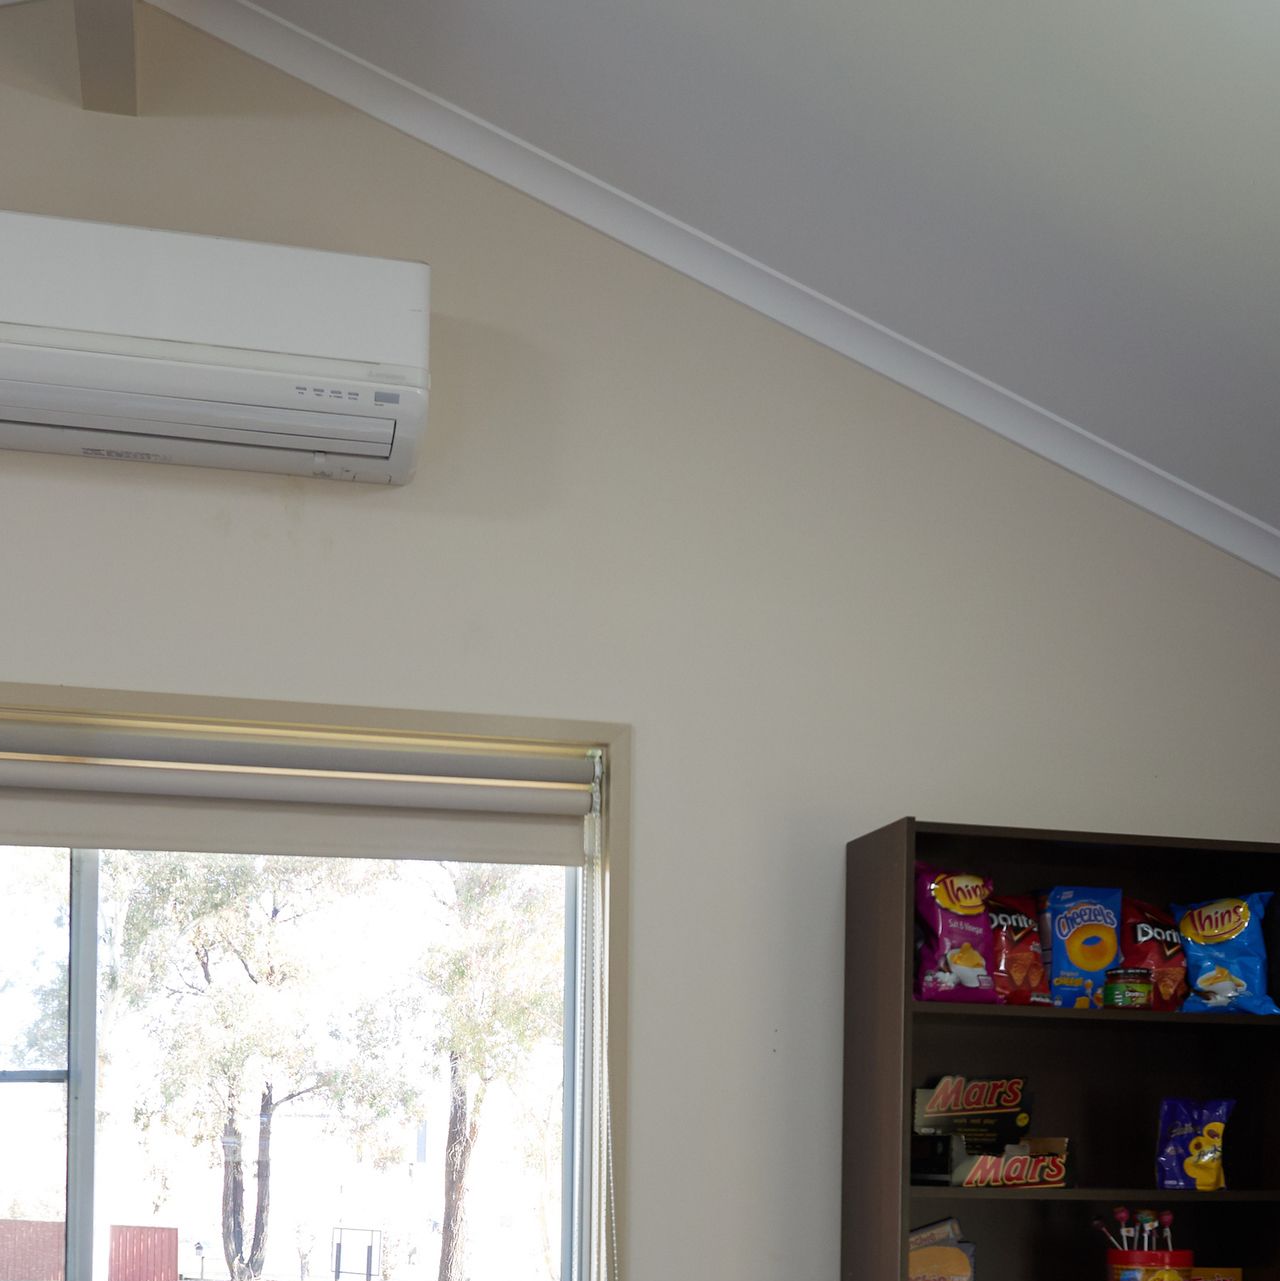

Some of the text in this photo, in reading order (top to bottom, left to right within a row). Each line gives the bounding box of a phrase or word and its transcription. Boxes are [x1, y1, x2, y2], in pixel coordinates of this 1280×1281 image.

[1057, 904, 1117, 939] Cheezels
[1136, 922, 1182, 943] Dori
[1187, 904, 1244, 935] Thins
[926, 1075, 1023, 1112] Mars
[962, 1153, 1066, 1187] Mars
